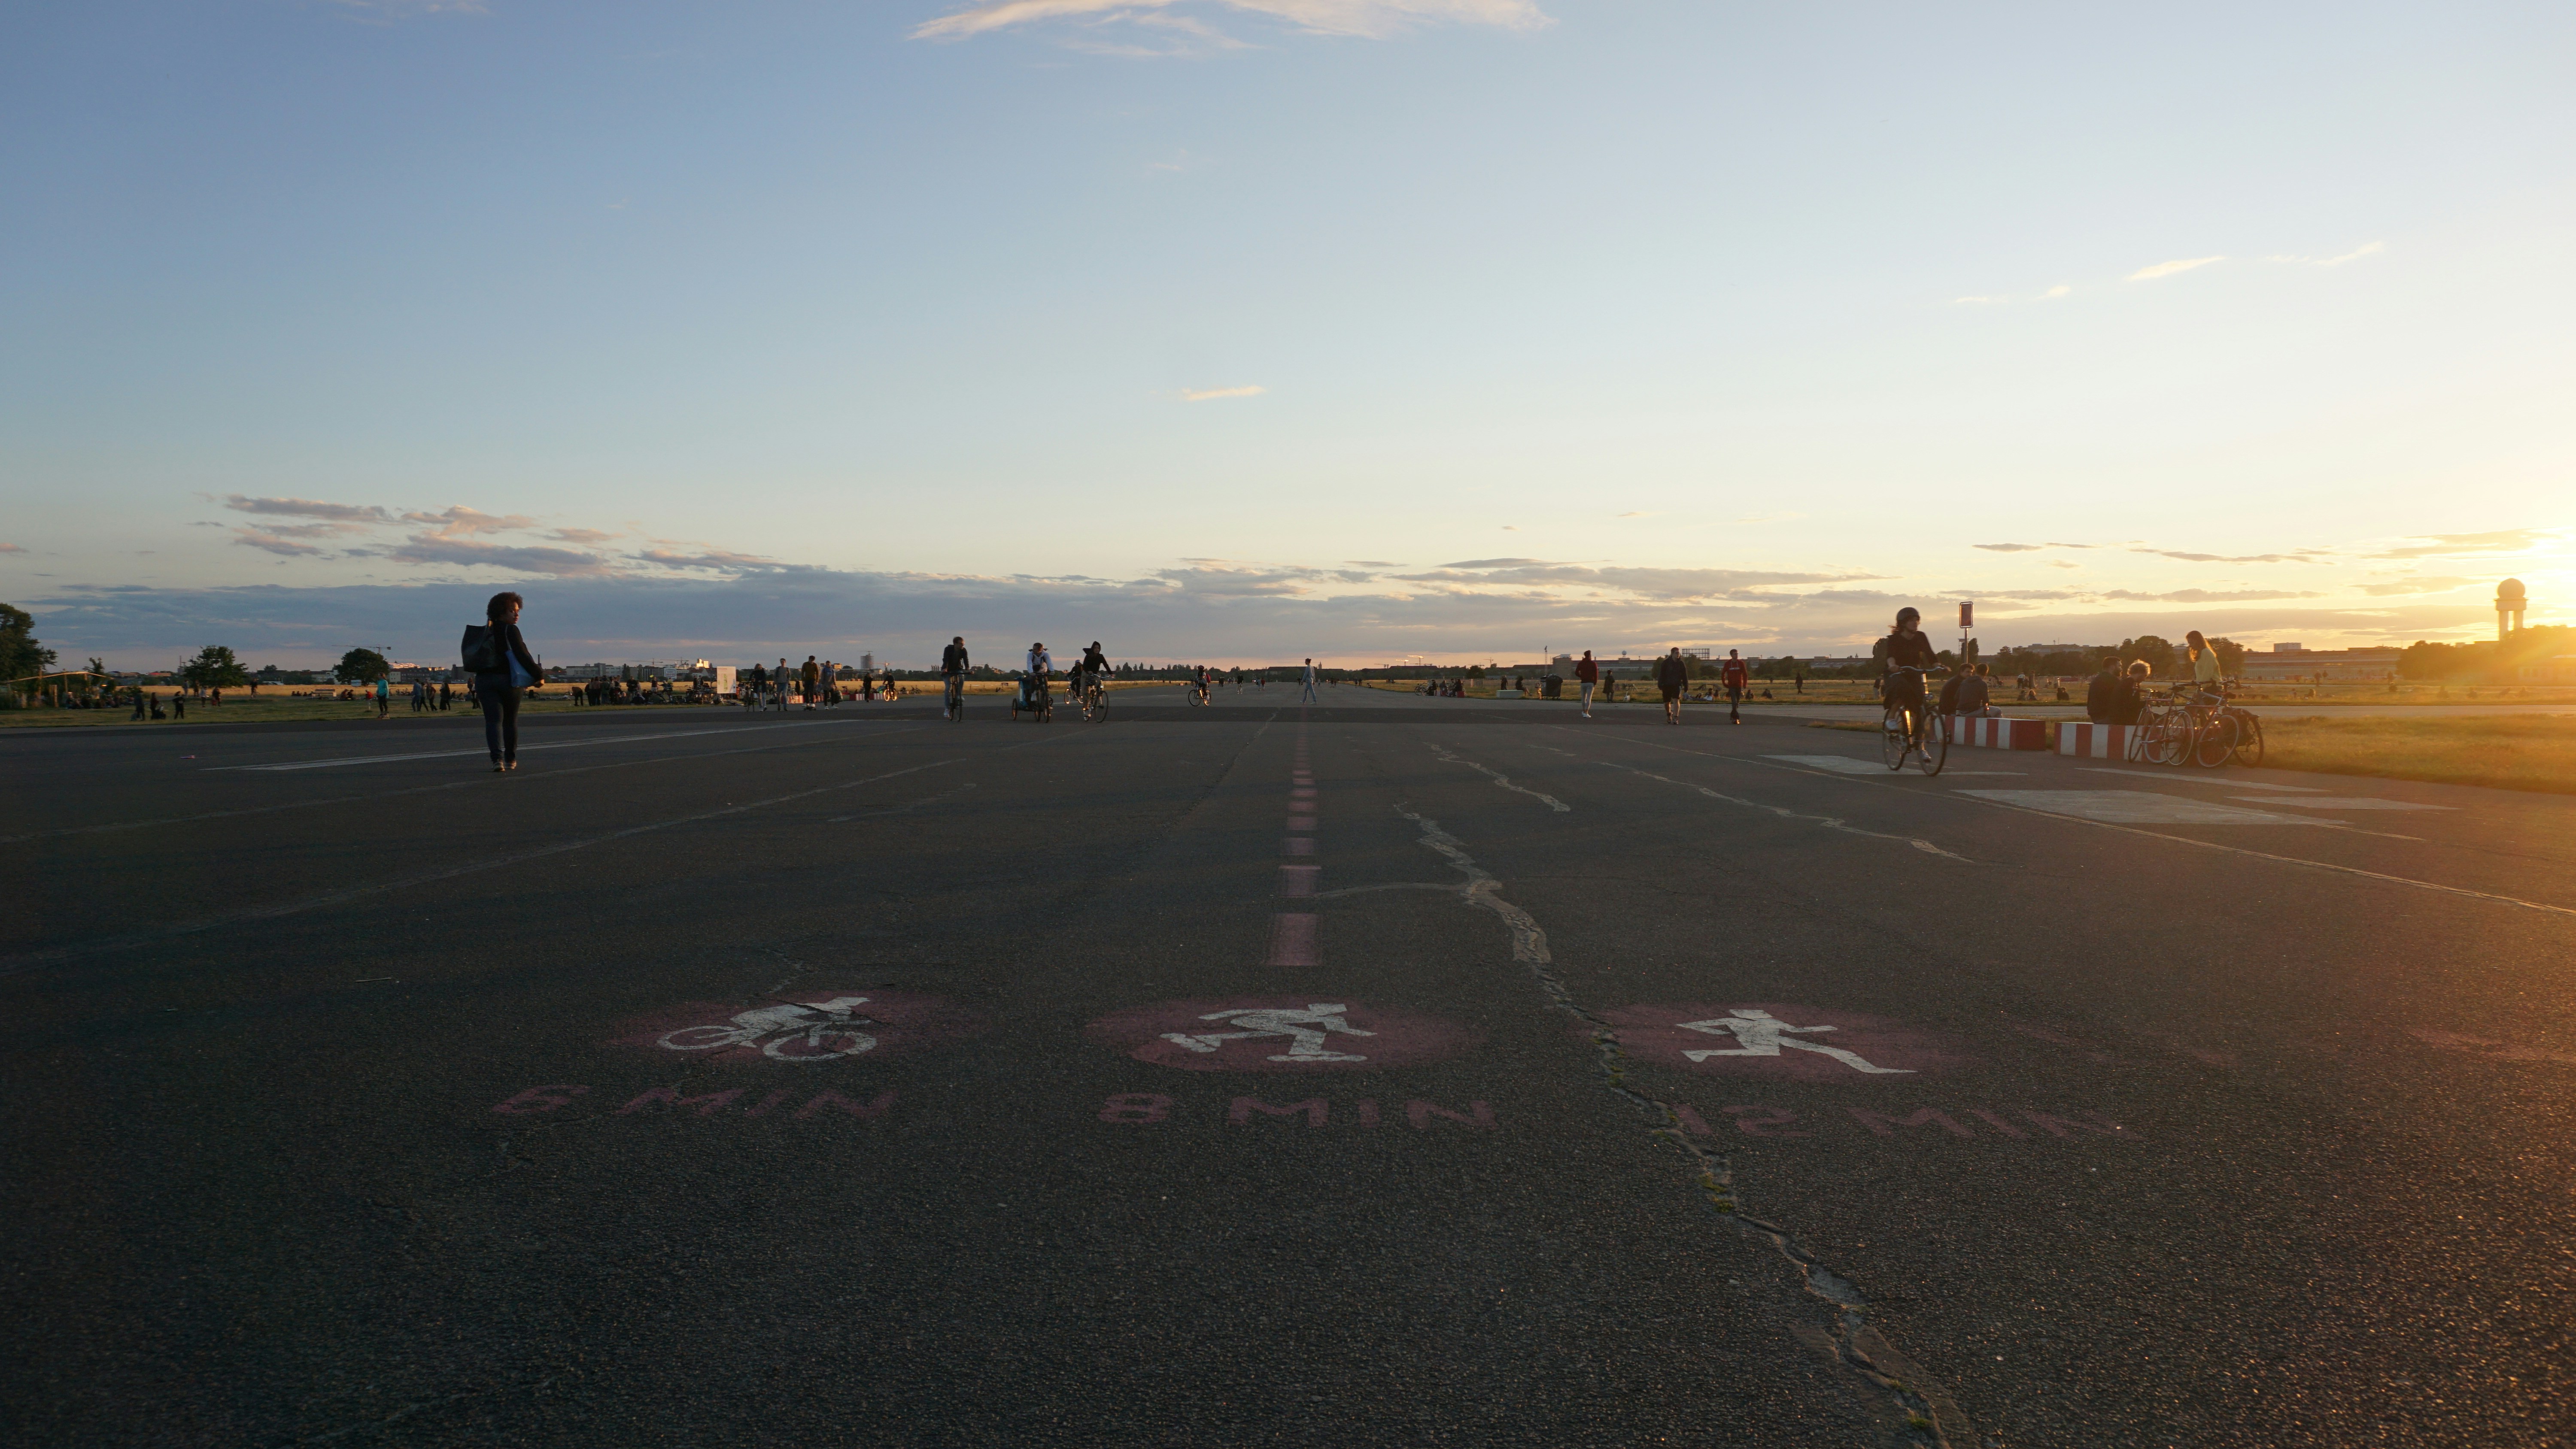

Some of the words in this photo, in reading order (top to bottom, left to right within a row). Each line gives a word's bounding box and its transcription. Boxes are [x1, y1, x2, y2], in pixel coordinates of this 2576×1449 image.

[492, 1085, 592, 1113] 6
[613, 1088, 899, 1119] MIN
[1098, 1093, 1176, 1124] 8
[1229, 1097, 1496, 1130] MIN
[1673, 1104, 1813, 1137] 12
[1845, 1106, 2146, 1142] MIN
